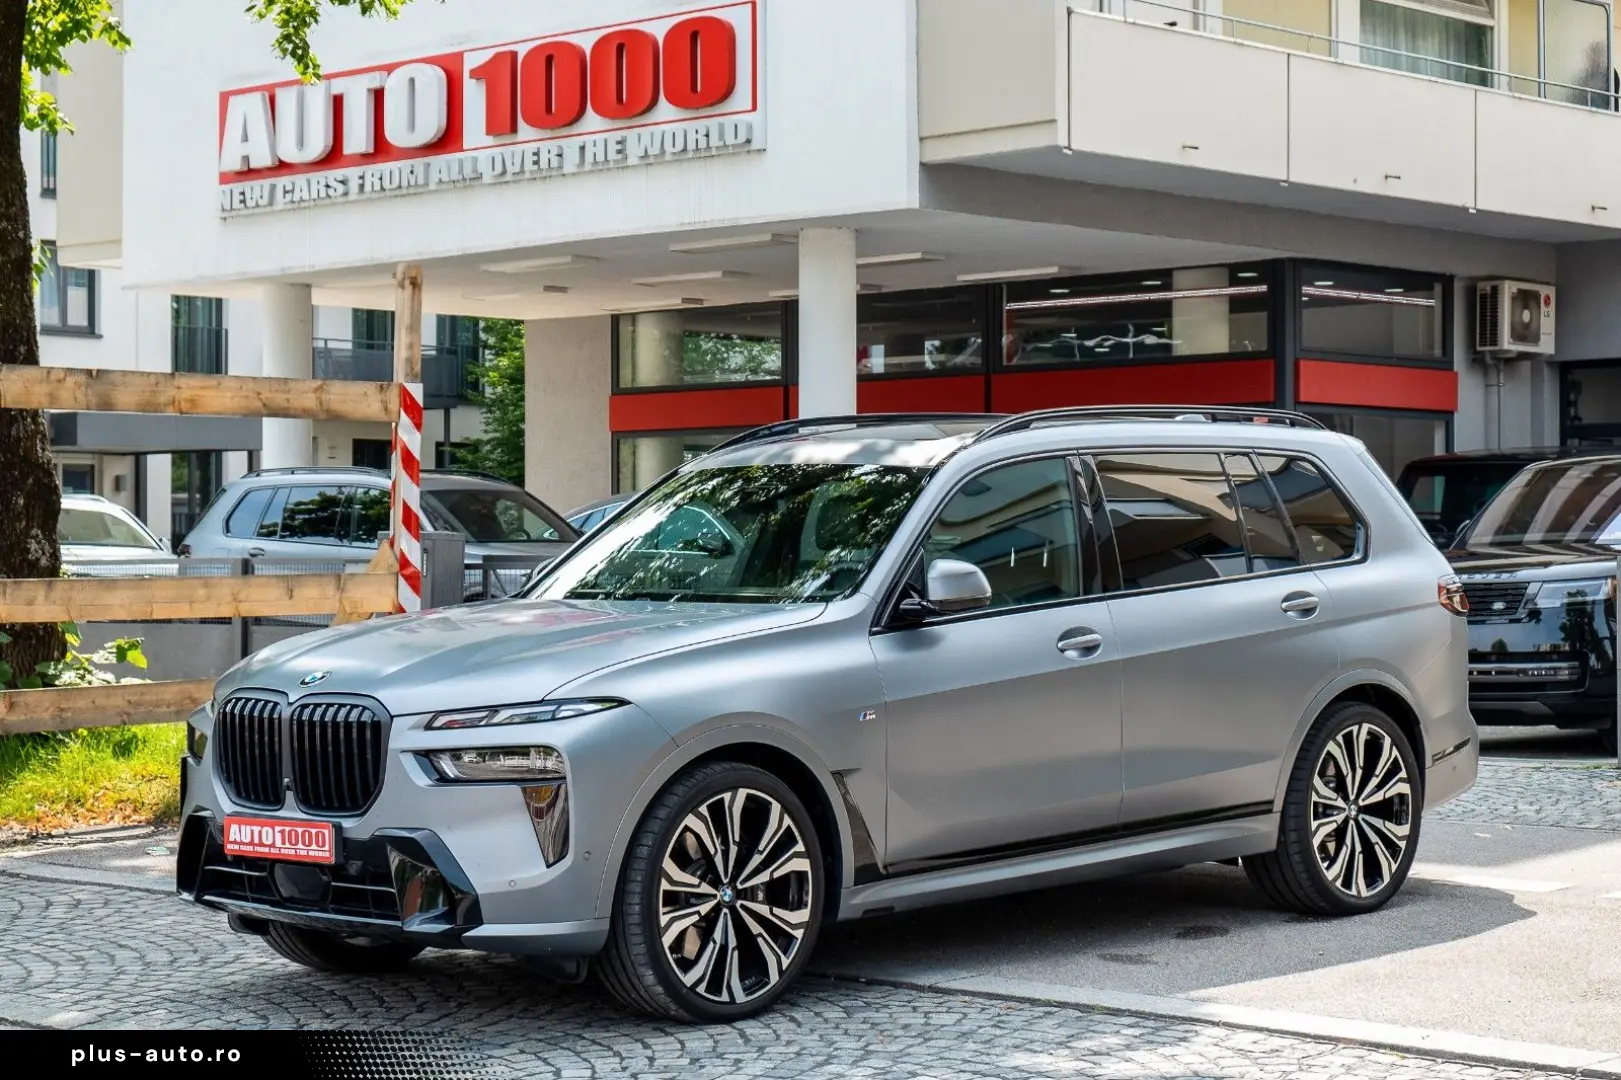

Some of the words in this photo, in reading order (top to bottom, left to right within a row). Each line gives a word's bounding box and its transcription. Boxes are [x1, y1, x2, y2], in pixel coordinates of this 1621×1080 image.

[220, 63, 448, 173] AUTO
[469, 15, 736, 137] 1000
[219, 183, 270, 212] NEW
[280, 174, 346, 204] CARS
[353, 163, 425, 193] FROM
[435, 154, 481, 182] ALL
[487, 145, 562, 175] OVER
[568, 135, 627, 164] THE
[633, 120, 753, 157] WORLD
[229, 824, 273, 845] AUTO
[277, 828, 326, 848] 1000
